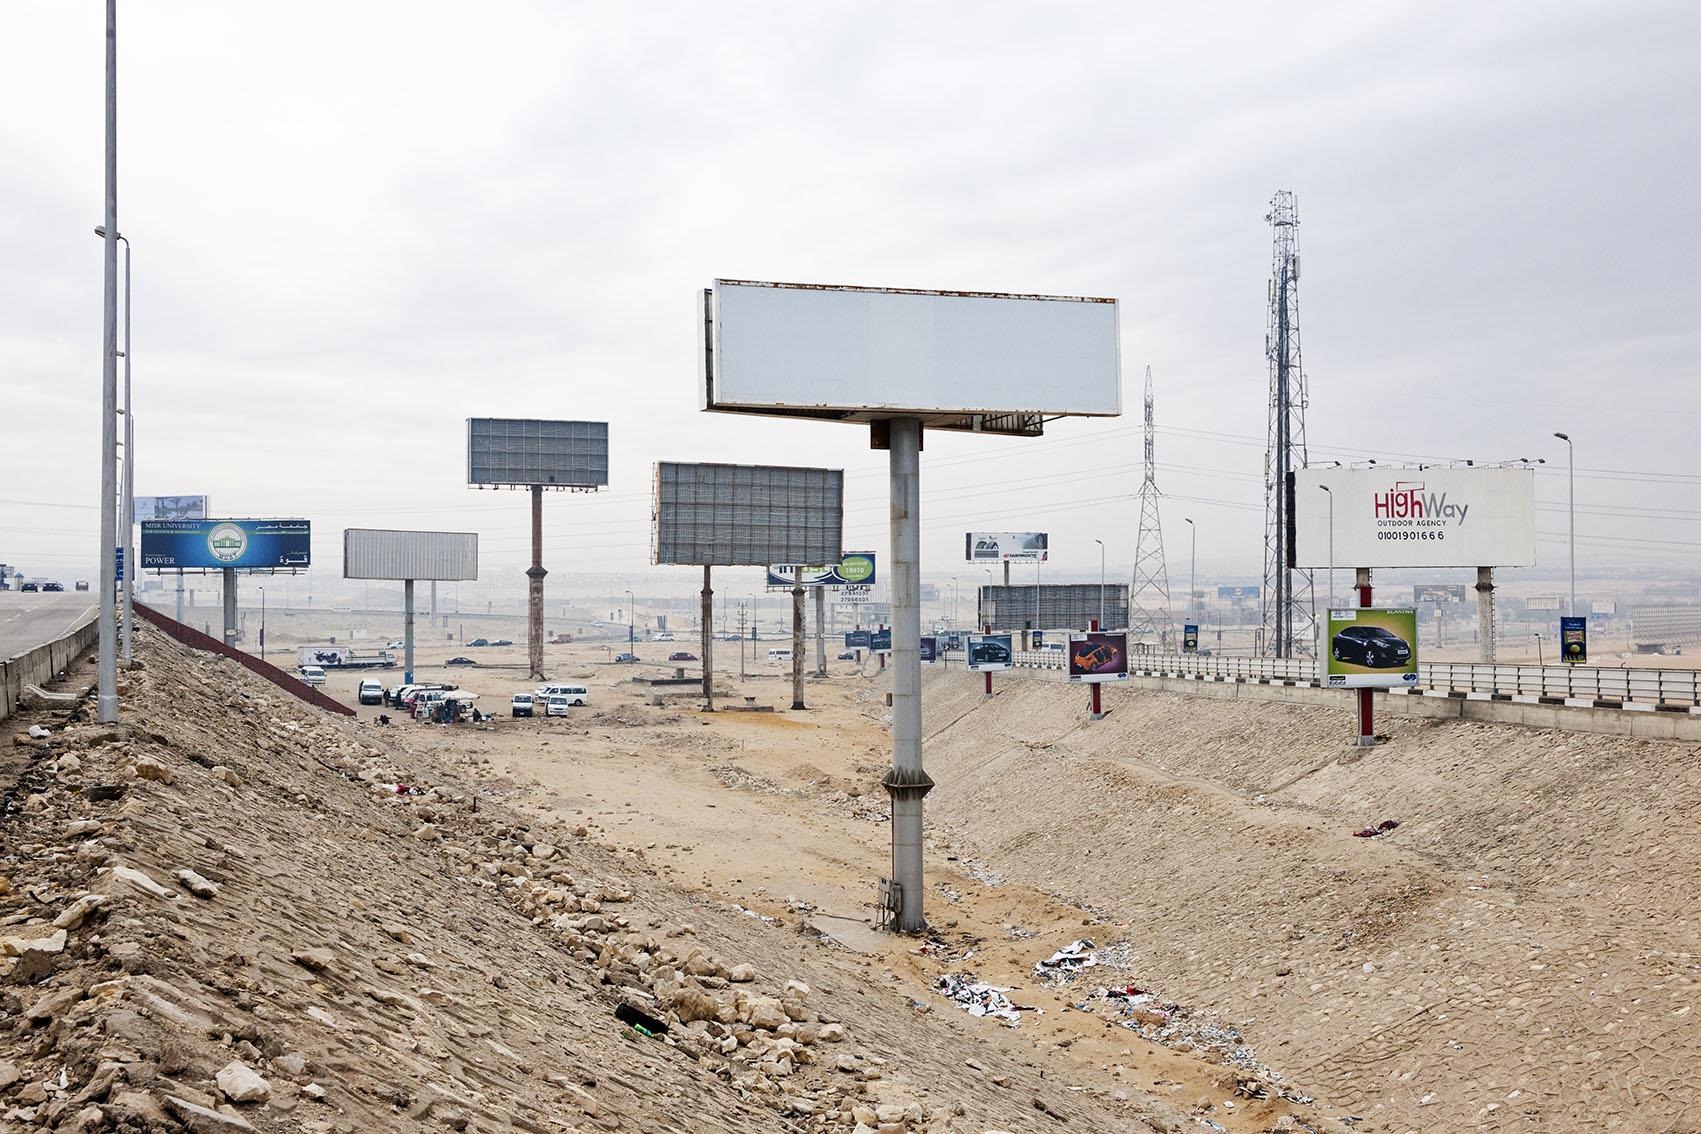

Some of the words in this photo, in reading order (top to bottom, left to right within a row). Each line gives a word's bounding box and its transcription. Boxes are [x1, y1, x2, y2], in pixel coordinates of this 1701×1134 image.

[1375, 488, 1469, 526] HighWay
[1377, 531, 1445, 540] 01001901666
[145, 557, 175, 565] POWER
